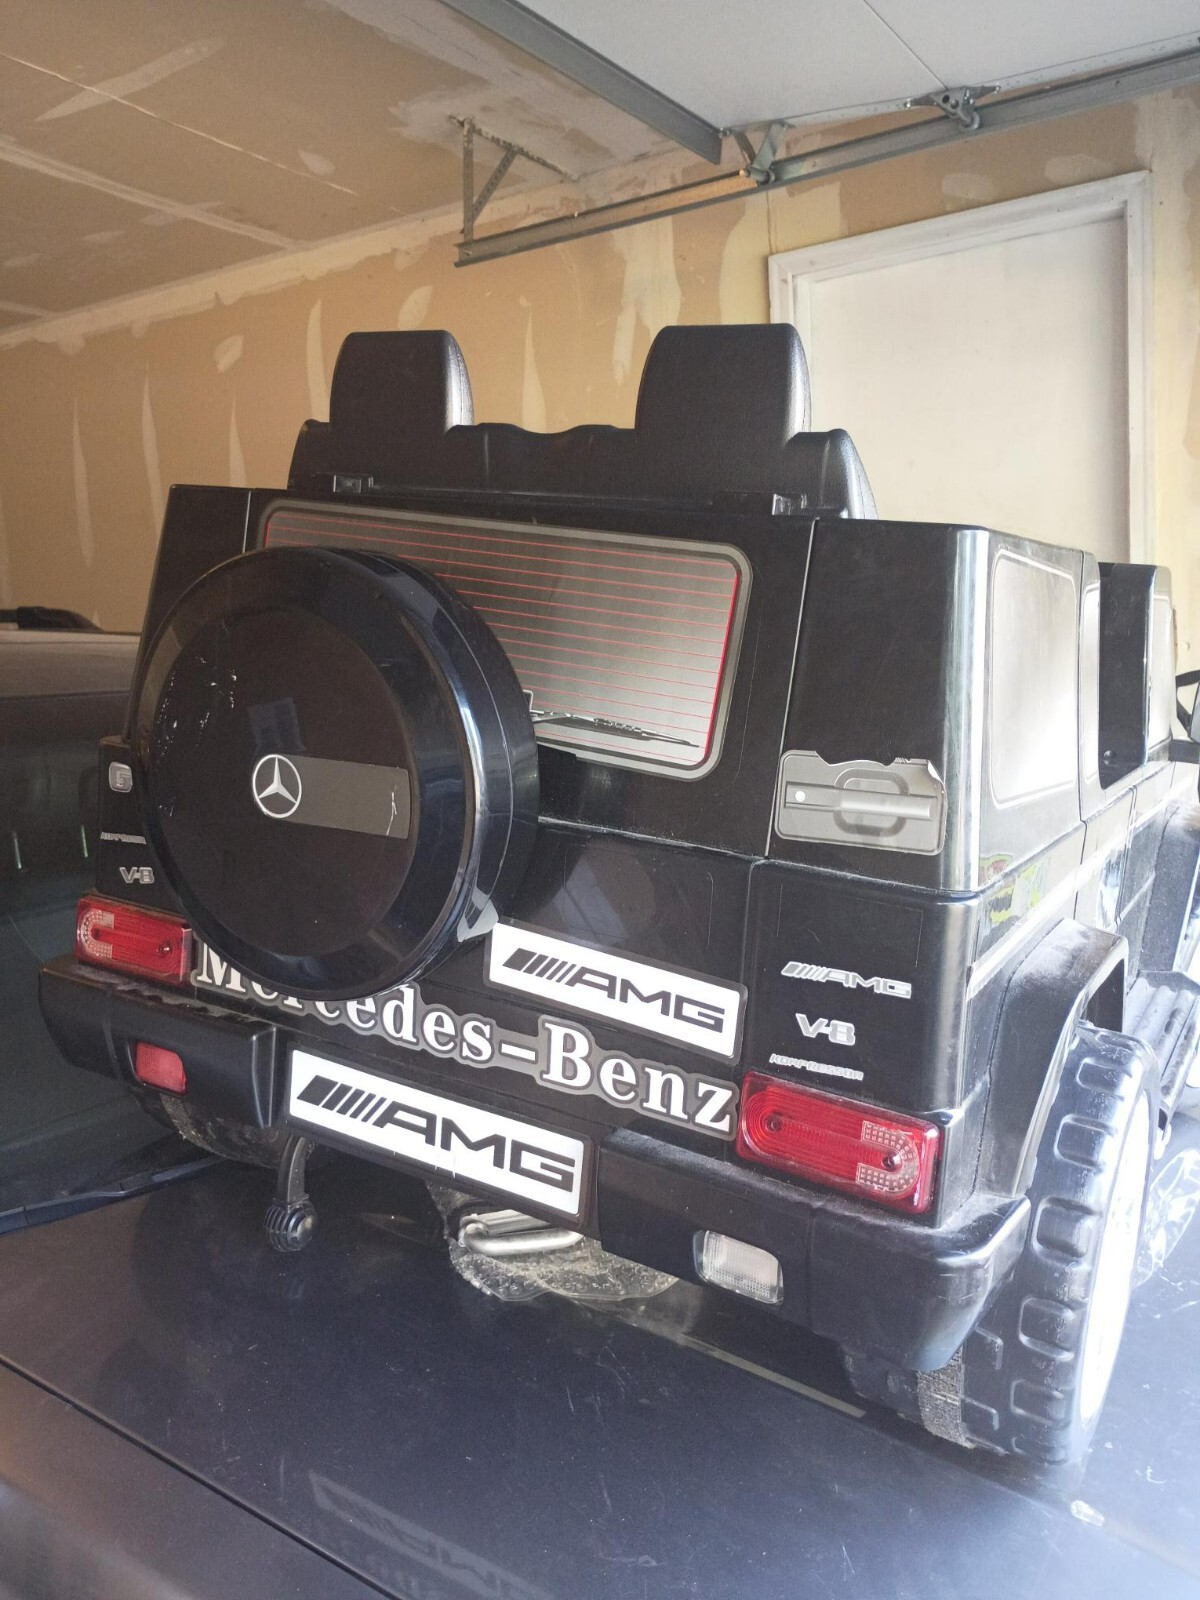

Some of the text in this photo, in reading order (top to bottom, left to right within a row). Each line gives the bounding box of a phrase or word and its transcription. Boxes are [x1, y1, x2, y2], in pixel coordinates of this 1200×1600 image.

[565, 966, 726, 1034] AMG
[821, 968, 912, 999] AMG
[371, 1100, 576, 1193] AMG
